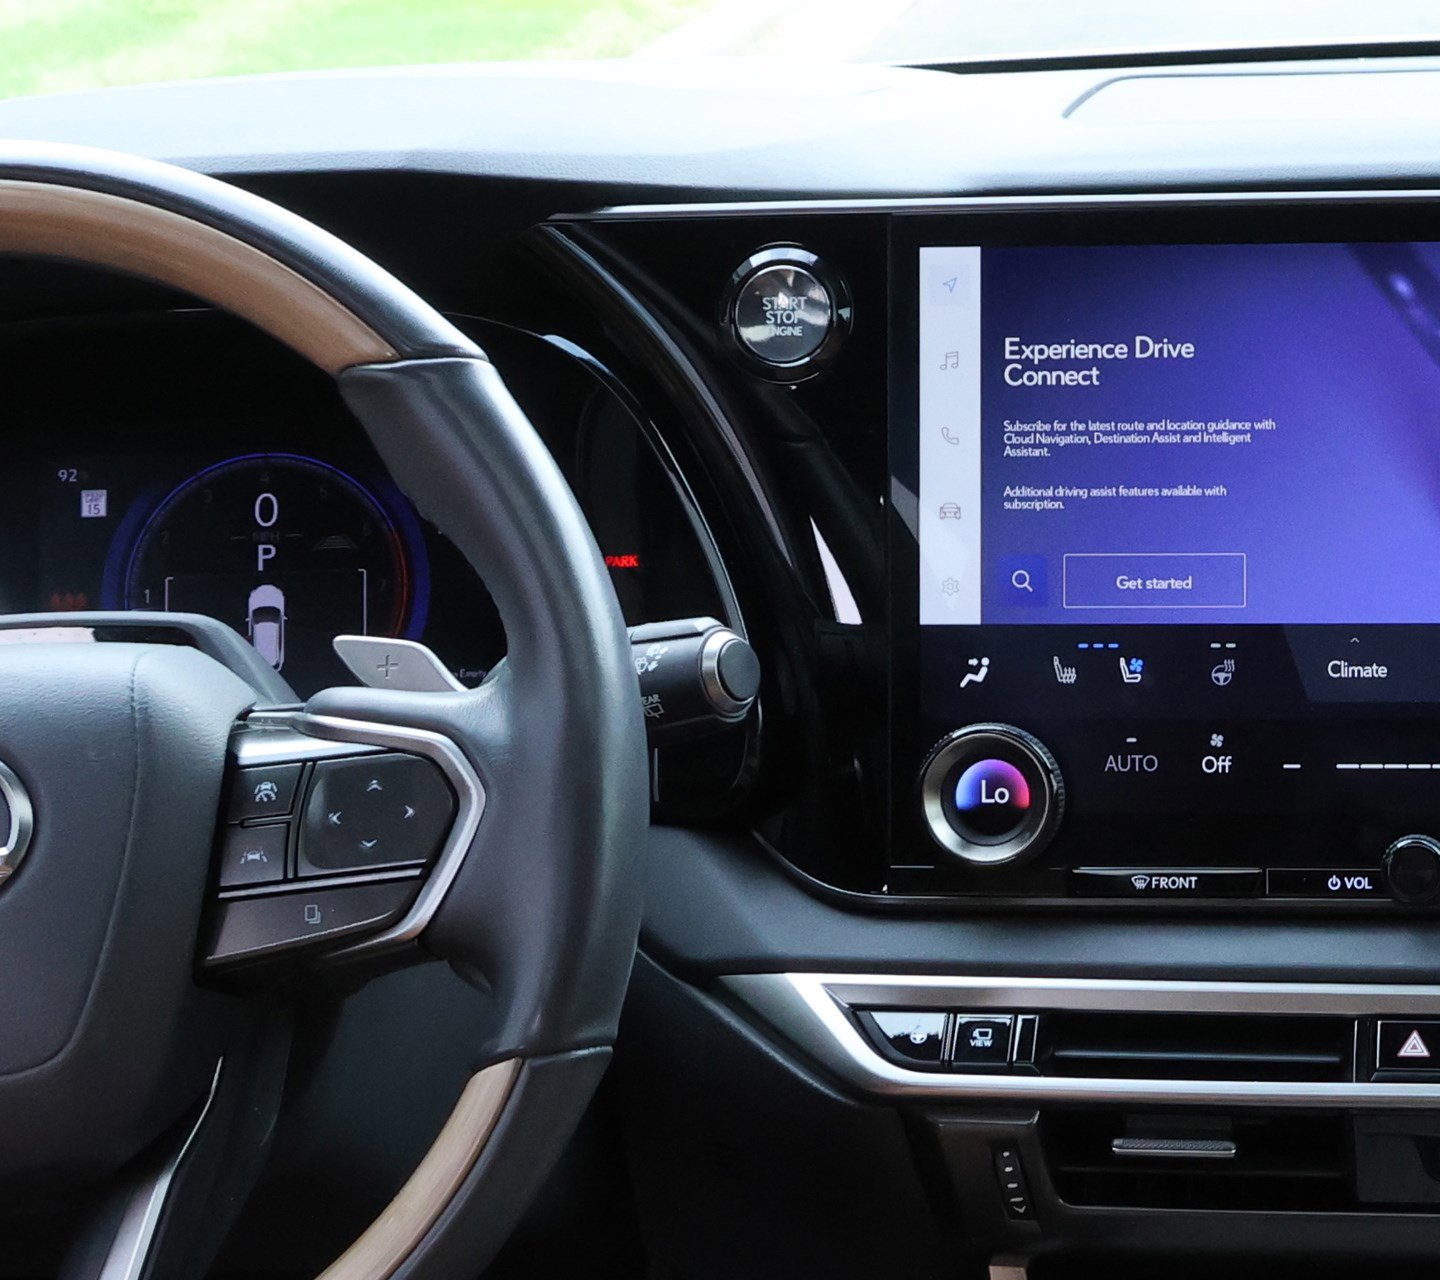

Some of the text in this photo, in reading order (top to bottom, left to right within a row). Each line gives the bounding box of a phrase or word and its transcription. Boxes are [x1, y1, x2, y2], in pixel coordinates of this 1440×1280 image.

[763, 297, 807, 310] START
[767, 326, 803, 336] NGINE
[1005, 336, 1194, 364] Experience Drive
[1005, 364, 1099, 386] Connect
[1004, 419, 1275, 433] Subscribe for the latest route and location guidance with
[1004, 431, 1251, 446] Cloud Navigation, Destination Assist and Intelligent
[1004, 446, 1050, 456] Assistant.
[58, 469, 78, 482] 92
[1004, 485, 1226, 499] Additional driving assist features available with
[88, 504, 100, 514] 15
[1004, 499, 1064, 511] subscription.
[256, 543, 278, 572] P
[1117, 576, 1191, 589] Get started
[1328, 661, 1387, 677] Climate
[641, 694, 661, 705] EAR
[1105, 755, 1157, 771] AUTO
[1202, 756, 1232, 773] Off
[979, 778, 1011, 806] Lo
[1152, 877, 1197, 888] FRONT
[1345, 877, 1372, 889] VOL
